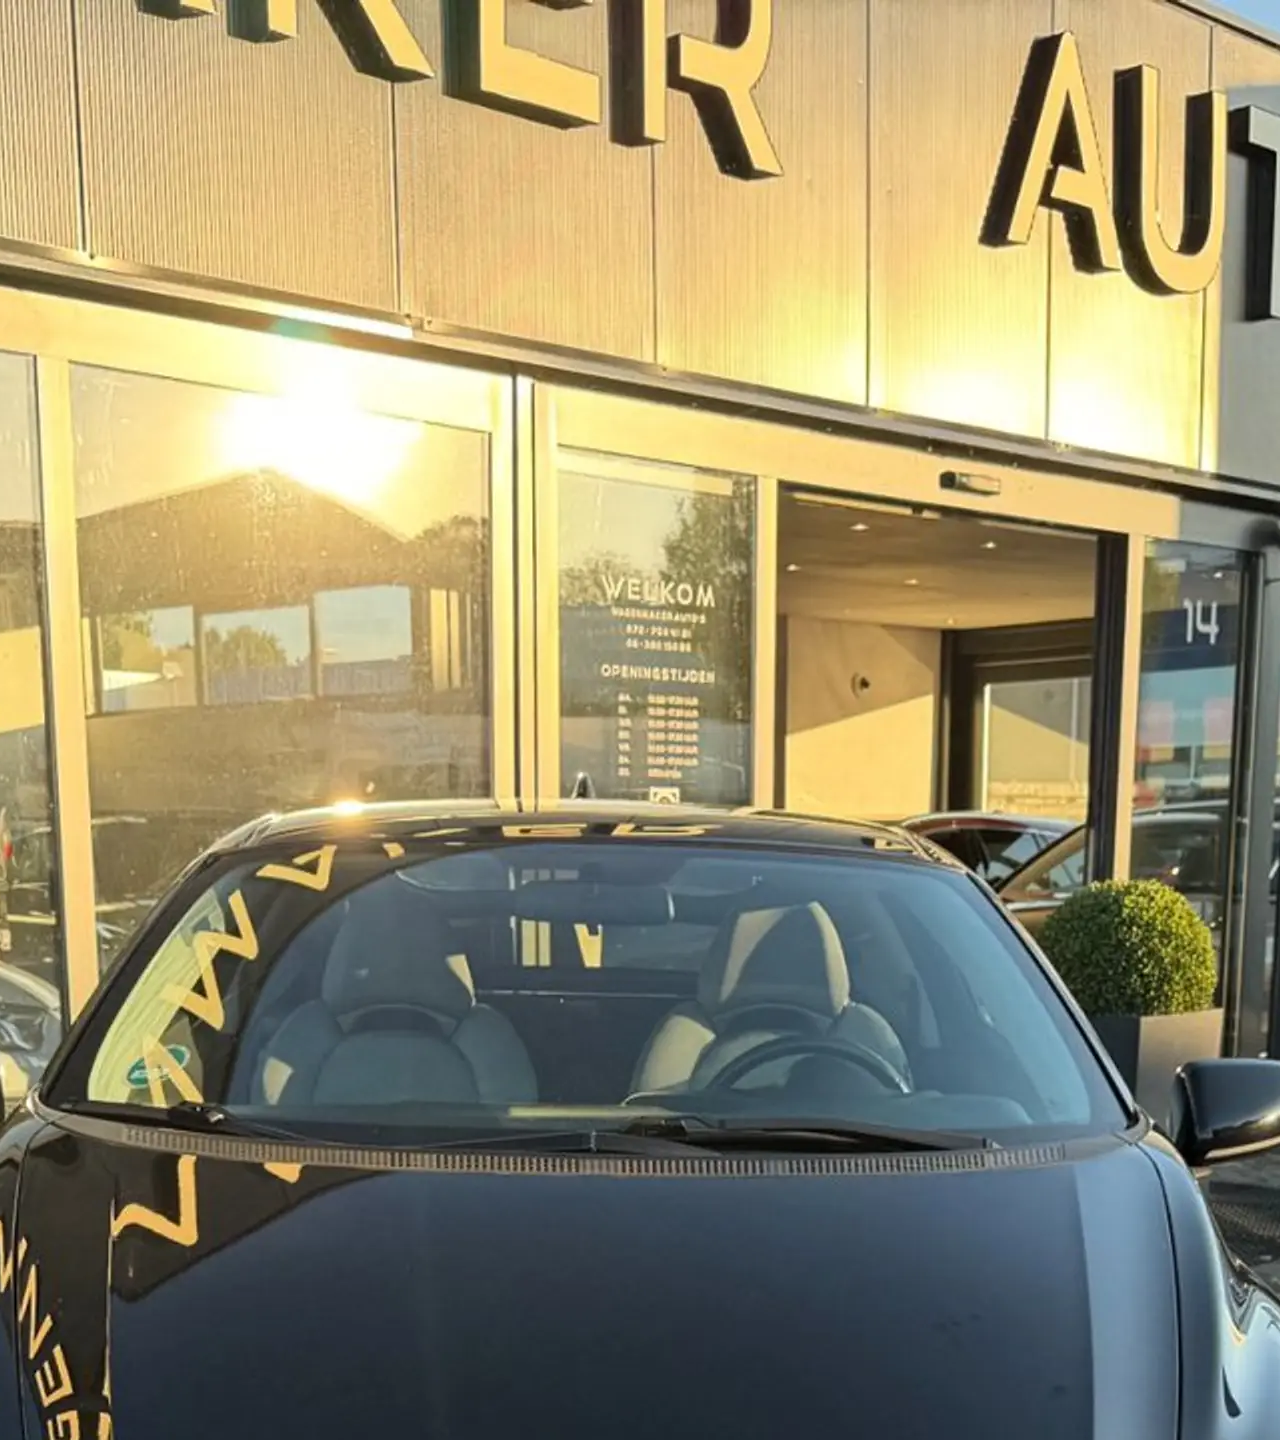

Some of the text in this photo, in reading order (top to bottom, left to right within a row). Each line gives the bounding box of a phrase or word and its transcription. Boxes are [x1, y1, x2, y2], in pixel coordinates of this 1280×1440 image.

[601, 573, 716, 608] WELKOM
[1182, 598, 1219, 646] 14
[601, 664, 716, 684] OPENINGSTIJDEN
